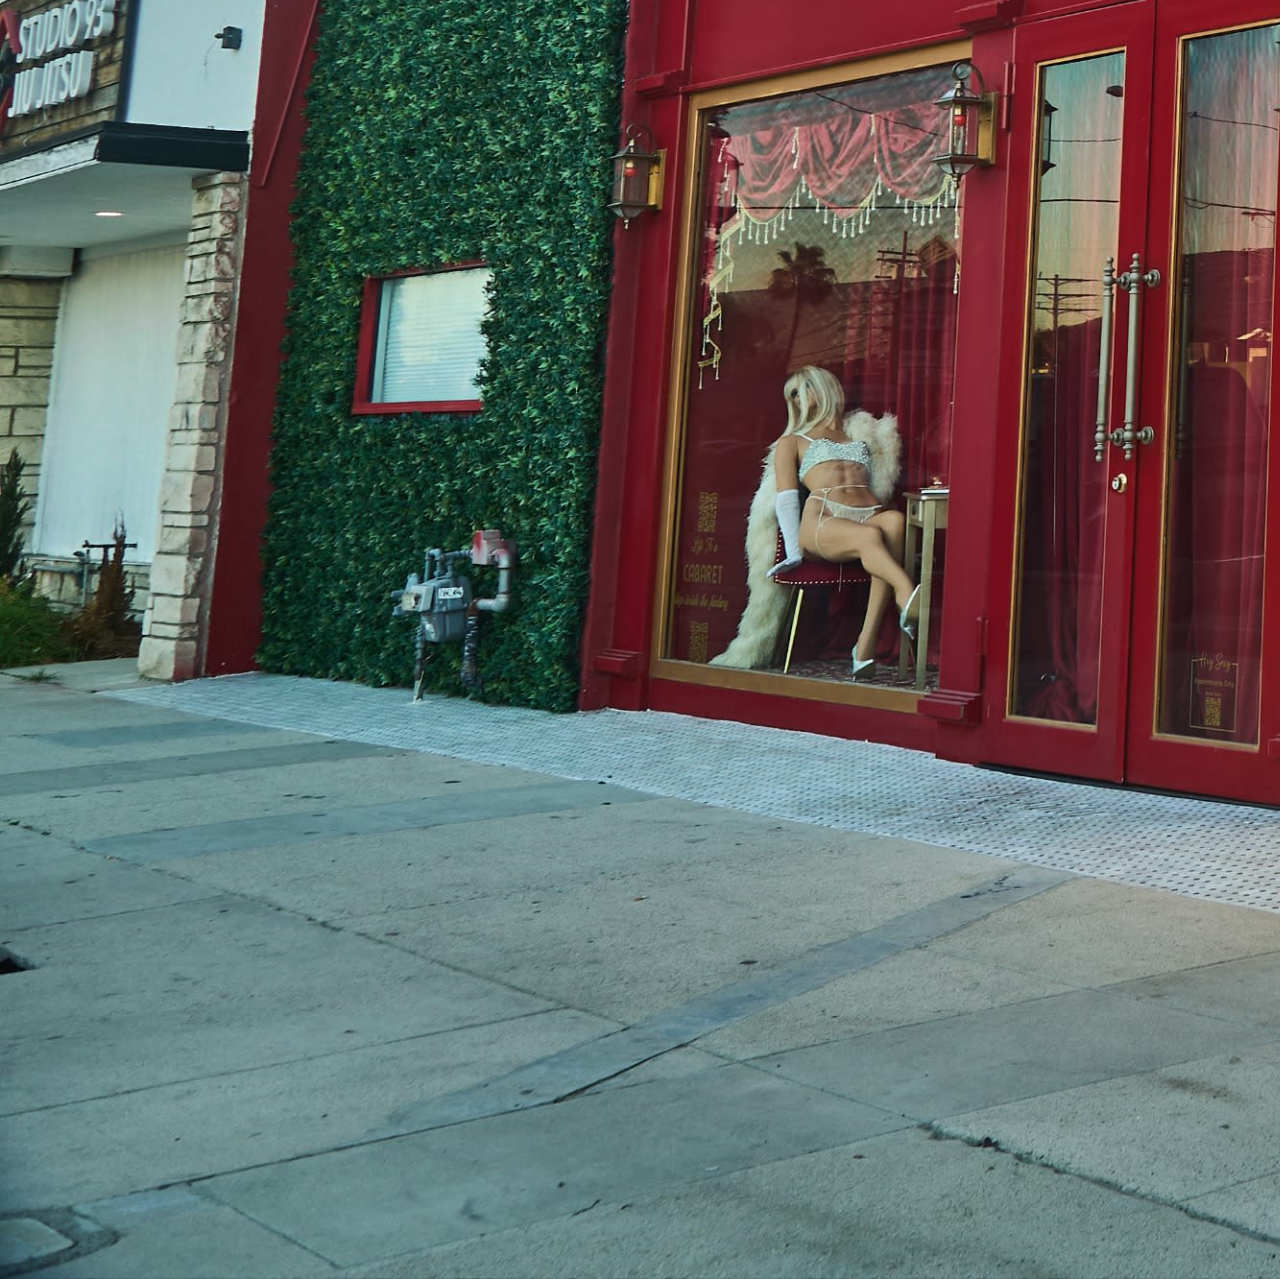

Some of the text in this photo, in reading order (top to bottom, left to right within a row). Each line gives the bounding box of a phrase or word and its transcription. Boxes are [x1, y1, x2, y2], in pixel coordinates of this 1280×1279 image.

[16, 0, 87, 63] STUDIO
[7, 67, 45, 118] JIU
[683, 564, 724, 585] CABARET
